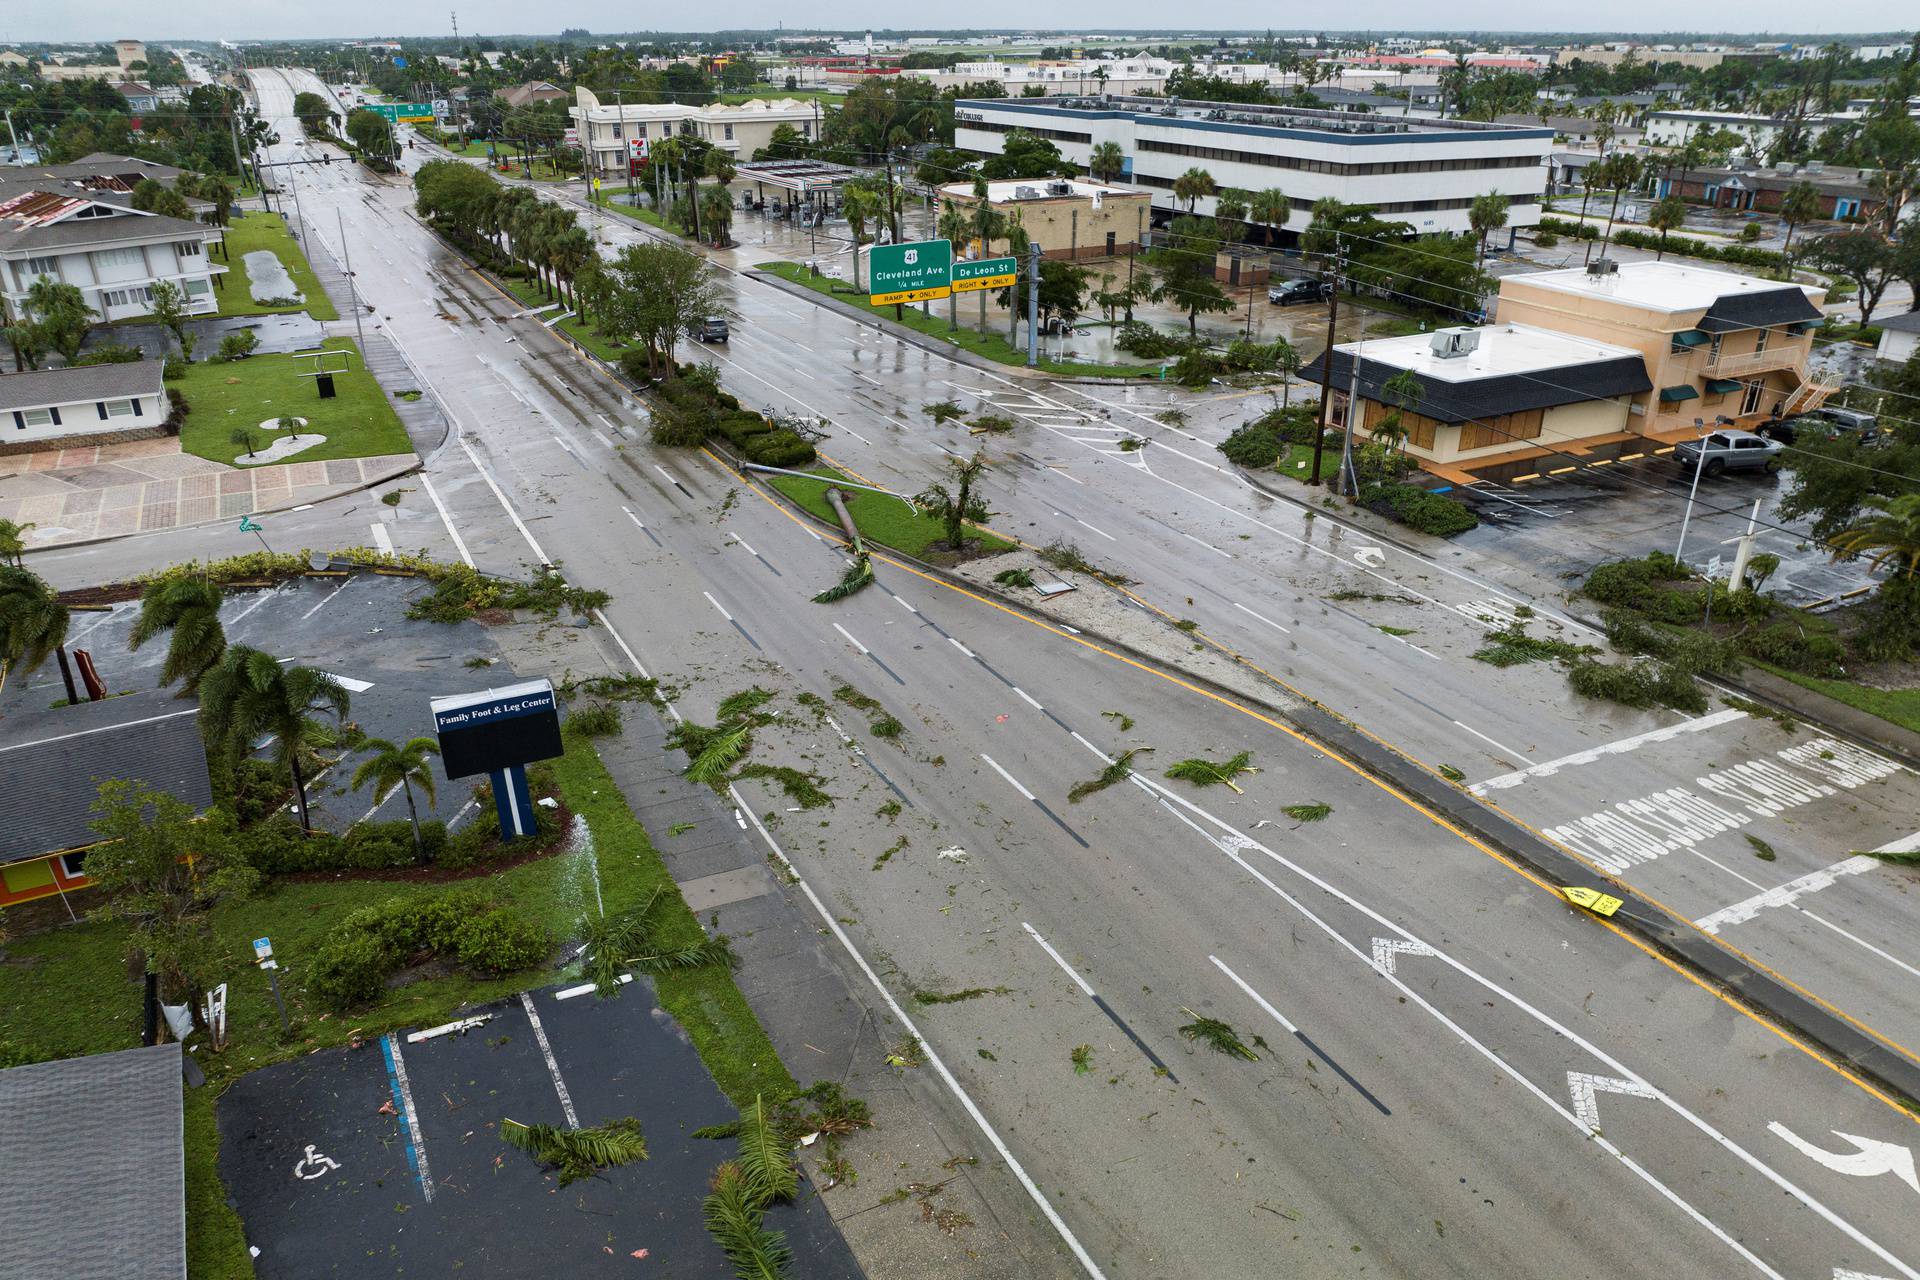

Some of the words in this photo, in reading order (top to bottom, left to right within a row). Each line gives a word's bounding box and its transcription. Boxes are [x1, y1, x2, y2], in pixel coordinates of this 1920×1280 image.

[963, 112, 984, 121] COLLEGE
[906, 253, 916, 261] 41
[876, 268, 922, 280] Cleveland
[927, 266, 945, 275] Ave.
[960, 269, 971, 277] De
[974, 267, 995, 275] Leon
[999, 264, 1008, 272] St
[958, 281, 976, 289] RIGHT
[440, 713, 470, 725] Family
[472, 709, 491, 719] Foot
[493, 706, 502, 715] &
[504, 703, 521, 712] Leg
[521, 697, 551, 709] Center
[1696, 759, 1838, 818] SCHOOL
[1615, 786, 1753, 848] SCHOOL
[1541, 809, 1682, 876] SCHOOL
